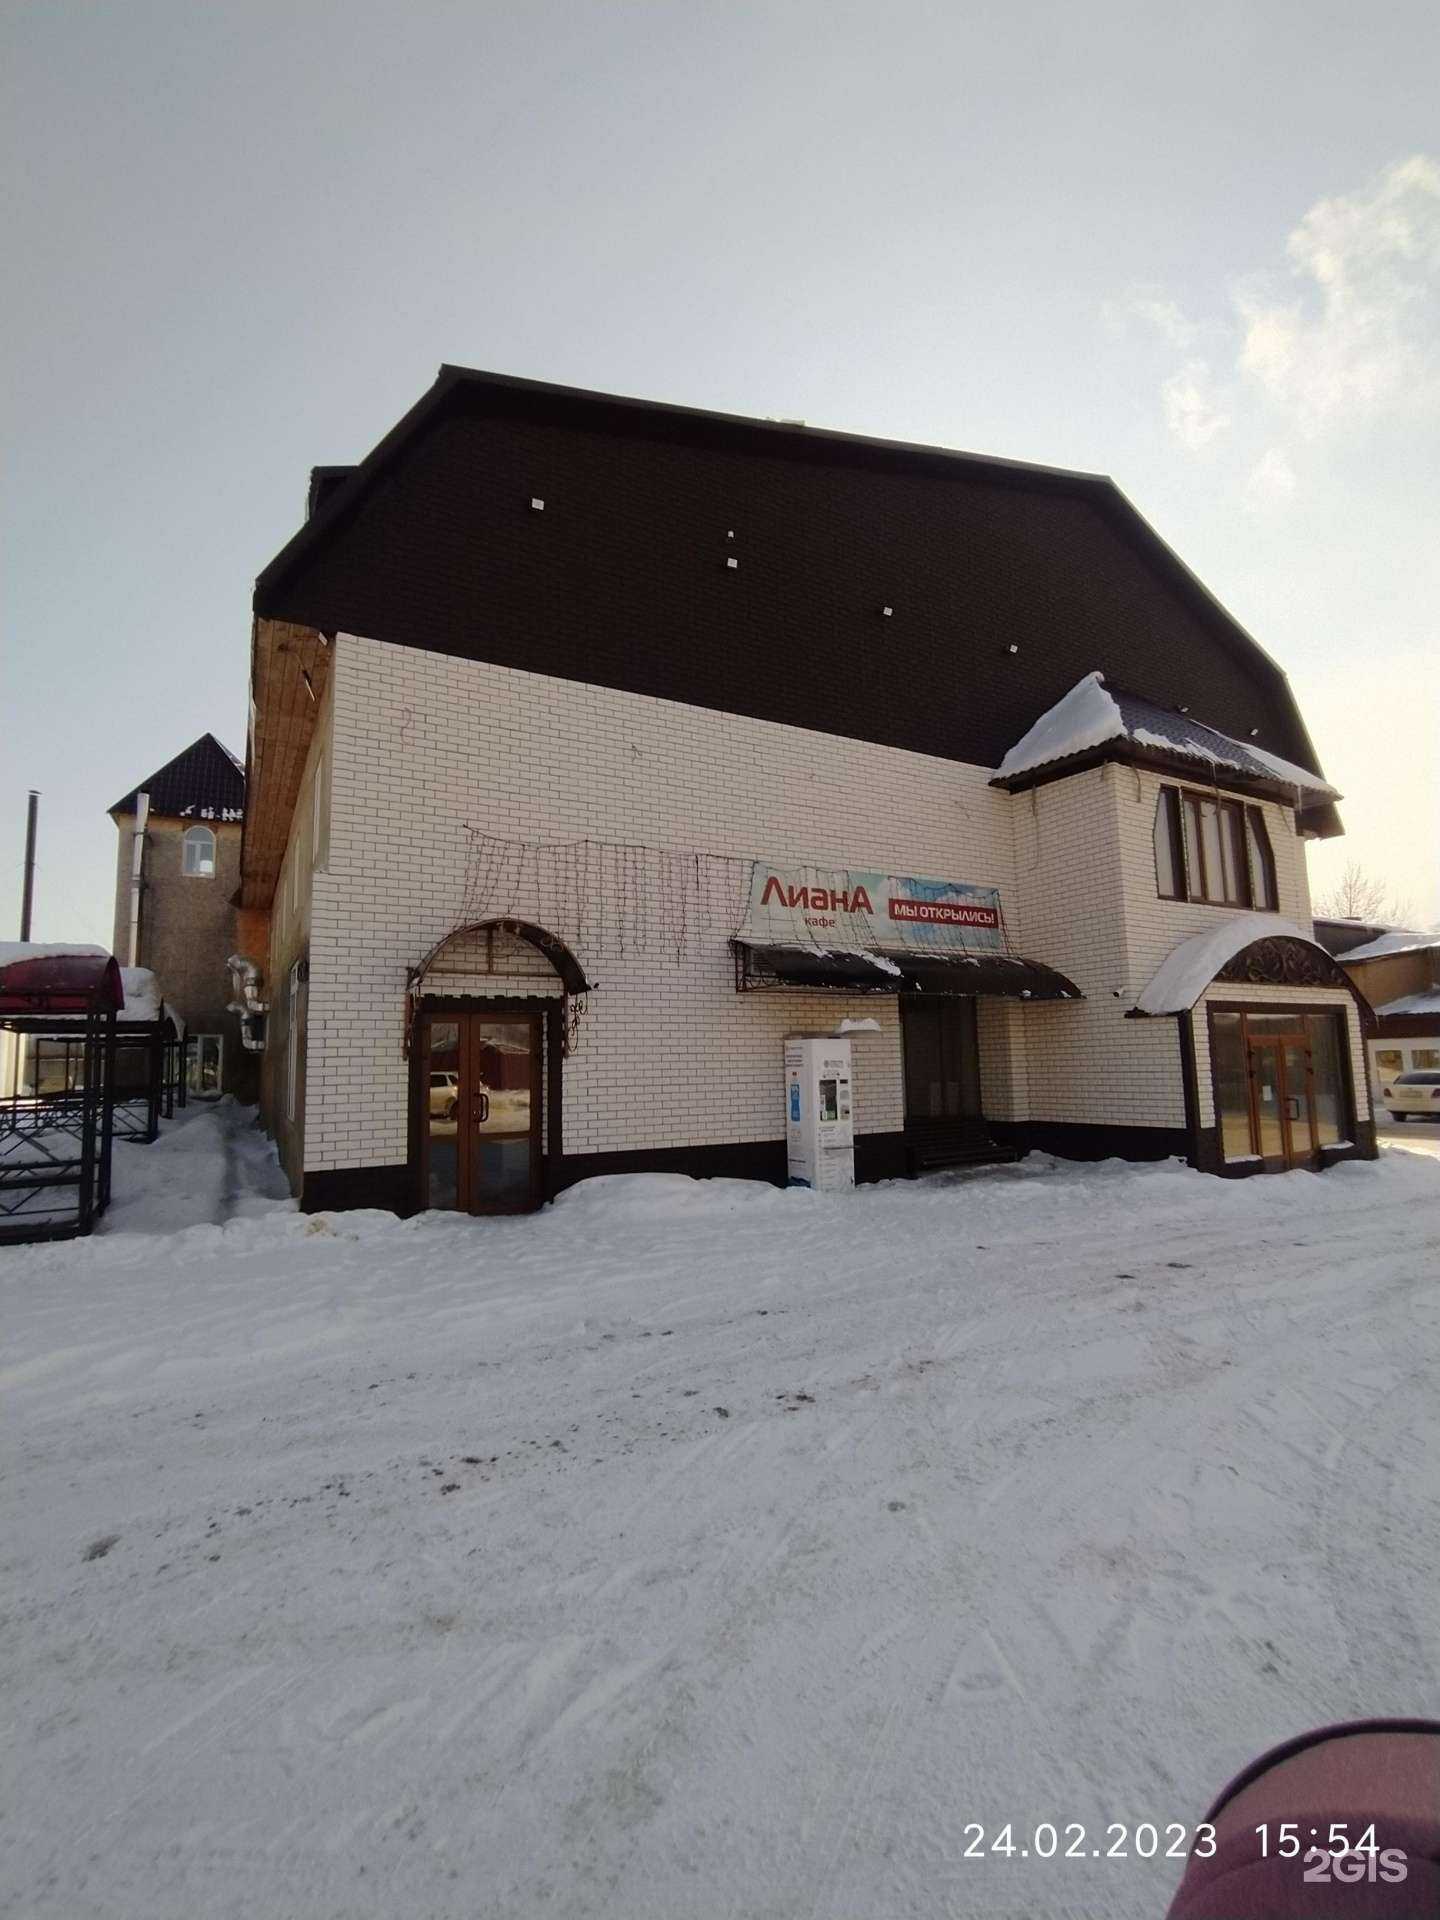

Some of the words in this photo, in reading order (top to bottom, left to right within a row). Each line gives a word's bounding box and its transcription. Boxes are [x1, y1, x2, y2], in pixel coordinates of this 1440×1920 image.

[894, 903, 917, 917] МЫ
[919, 906, 995, 925] ОТКРЫЛИСЬ!
[804, 917, 836, 929] кафе
